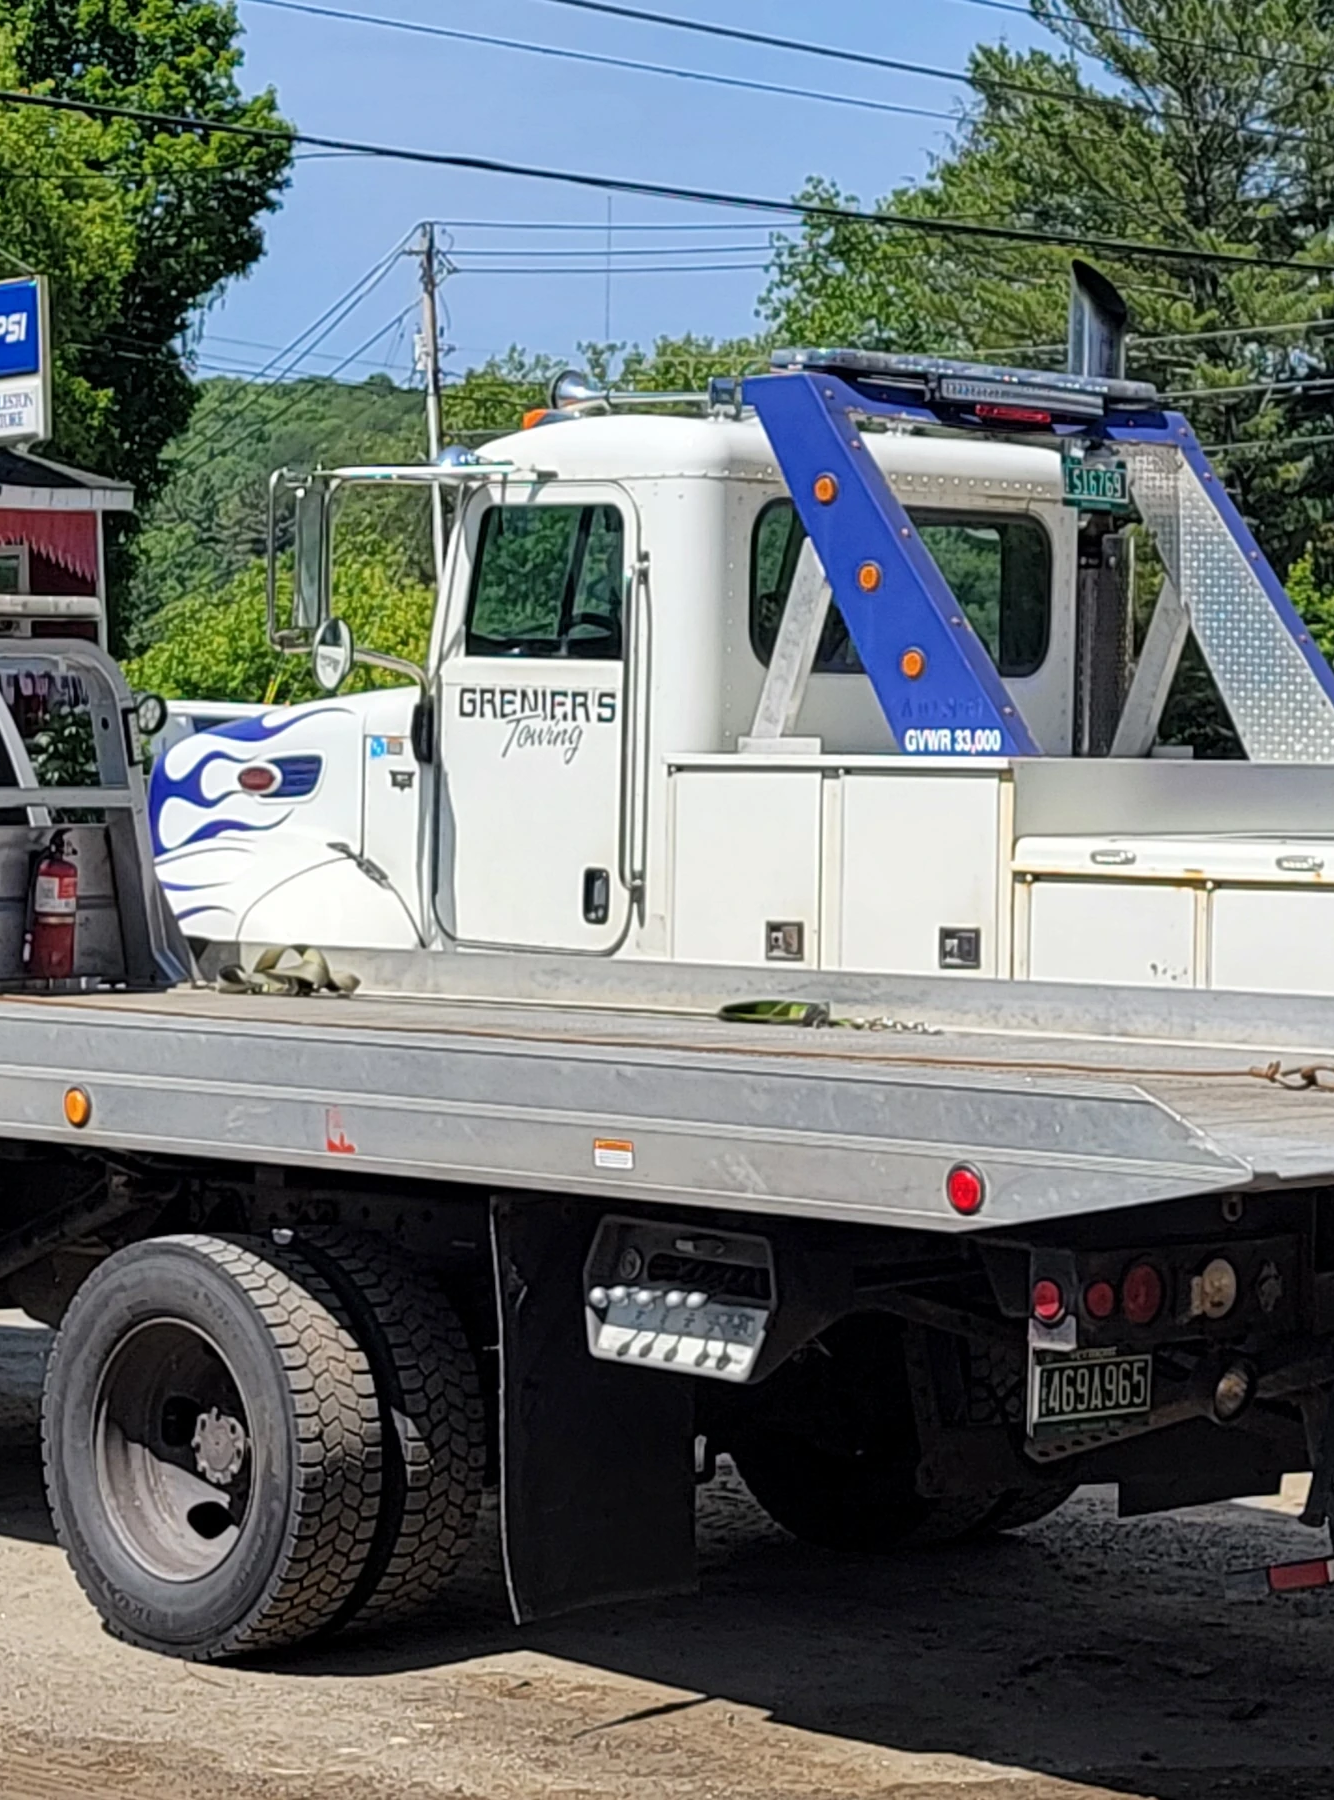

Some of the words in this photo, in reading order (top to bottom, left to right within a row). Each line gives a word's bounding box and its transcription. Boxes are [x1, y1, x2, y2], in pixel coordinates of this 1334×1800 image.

[458, 687, 617, 723] GRENIER'S
[500, 713, 584, 765] Towing
[904, 728, 952, 752] GVWR
[954, 728, 1002, 755] 33,000
[1048, 1361, 1146, 1414] 469A965
